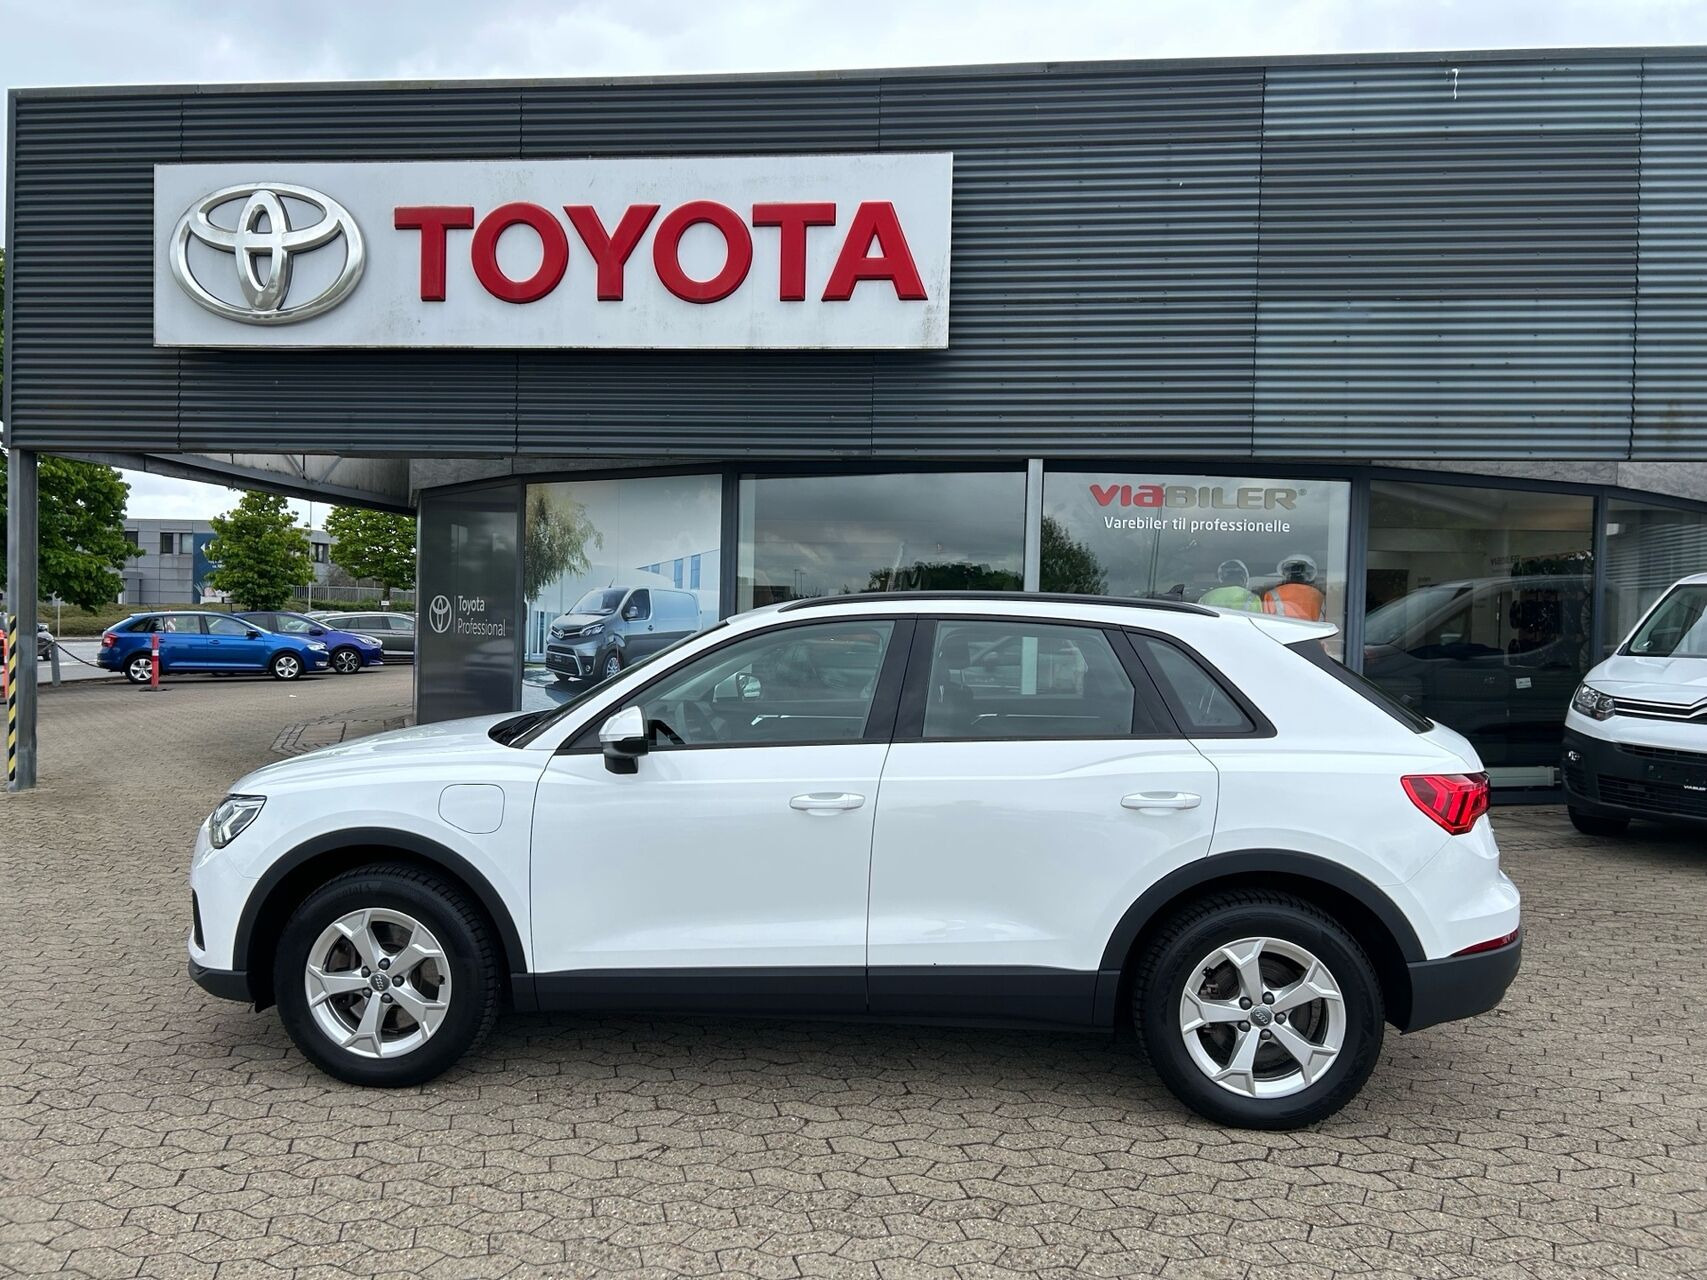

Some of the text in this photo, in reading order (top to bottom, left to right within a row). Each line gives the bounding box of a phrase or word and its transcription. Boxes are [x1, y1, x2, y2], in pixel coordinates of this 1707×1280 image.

[393, 200, 929, 305] TOYOTA
[1104, 516, 1291, 534] Varebiler til professionelle
[458, 595, 485, 615] Toyota
[458, 617, 506, 636] Professional
